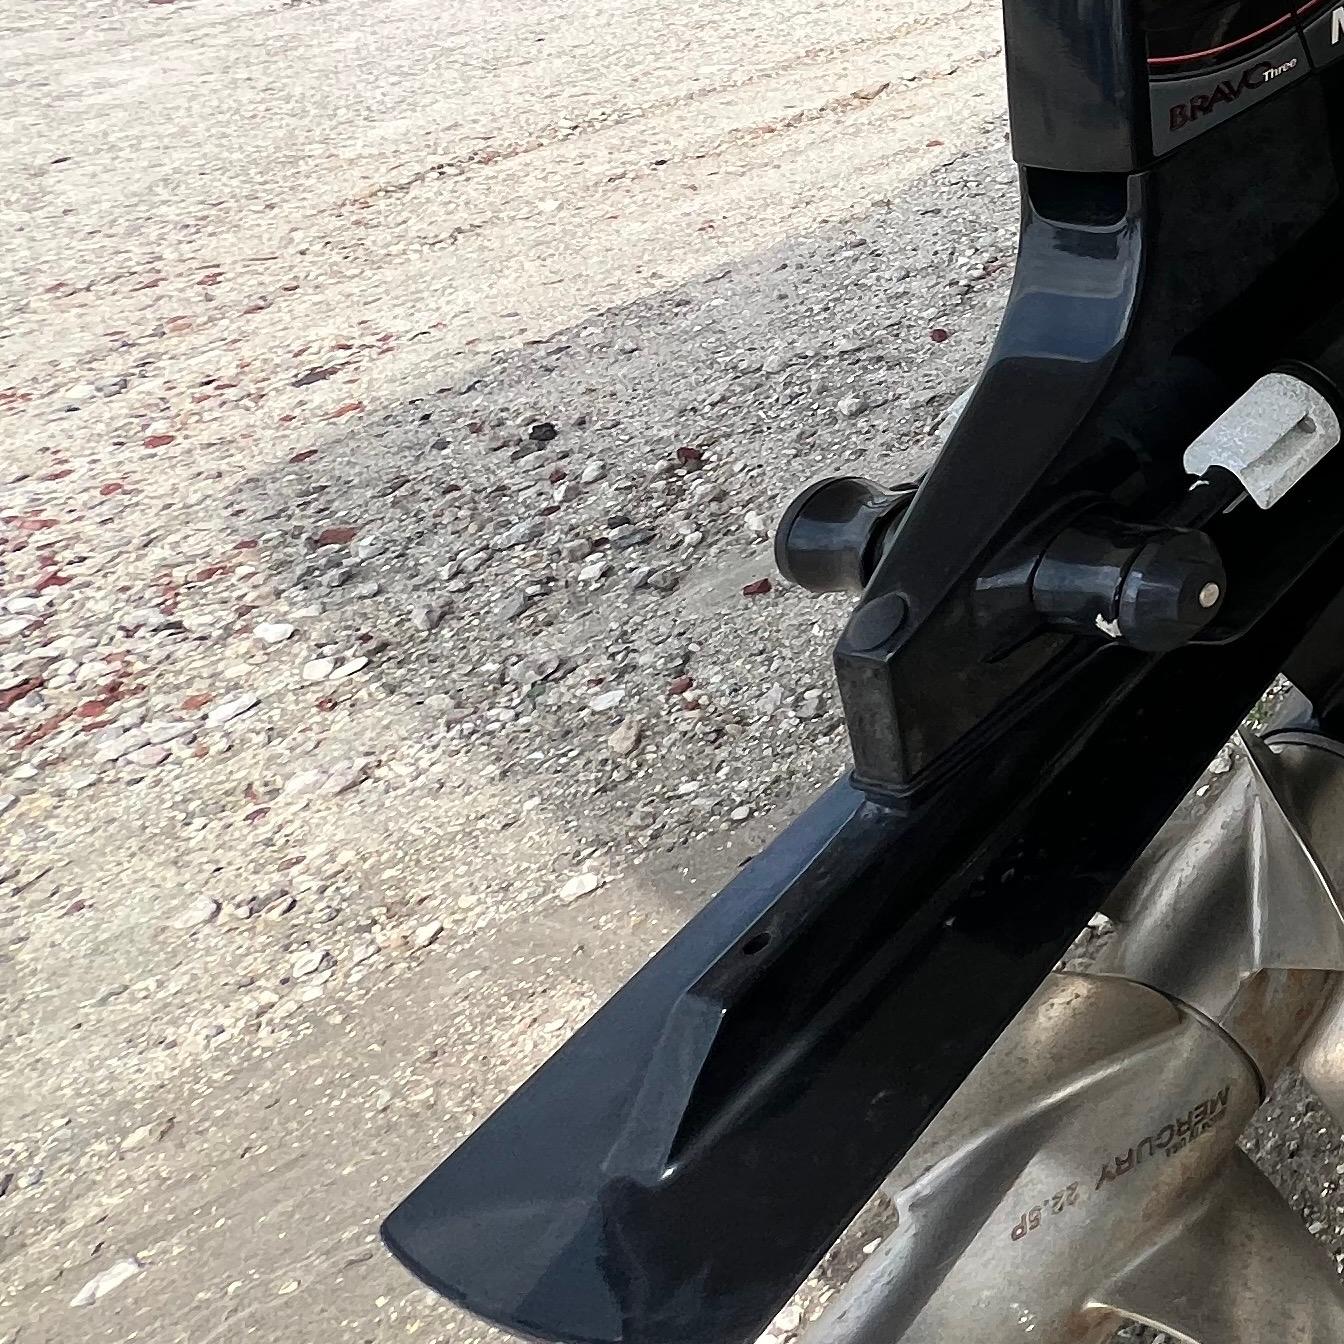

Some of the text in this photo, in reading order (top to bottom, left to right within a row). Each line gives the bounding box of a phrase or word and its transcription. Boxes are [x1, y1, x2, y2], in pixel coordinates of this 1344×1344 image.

[1169, 58, 1297, 129] BRAVO Three
[1095, 1086, 1230, 1190] MERCURY
